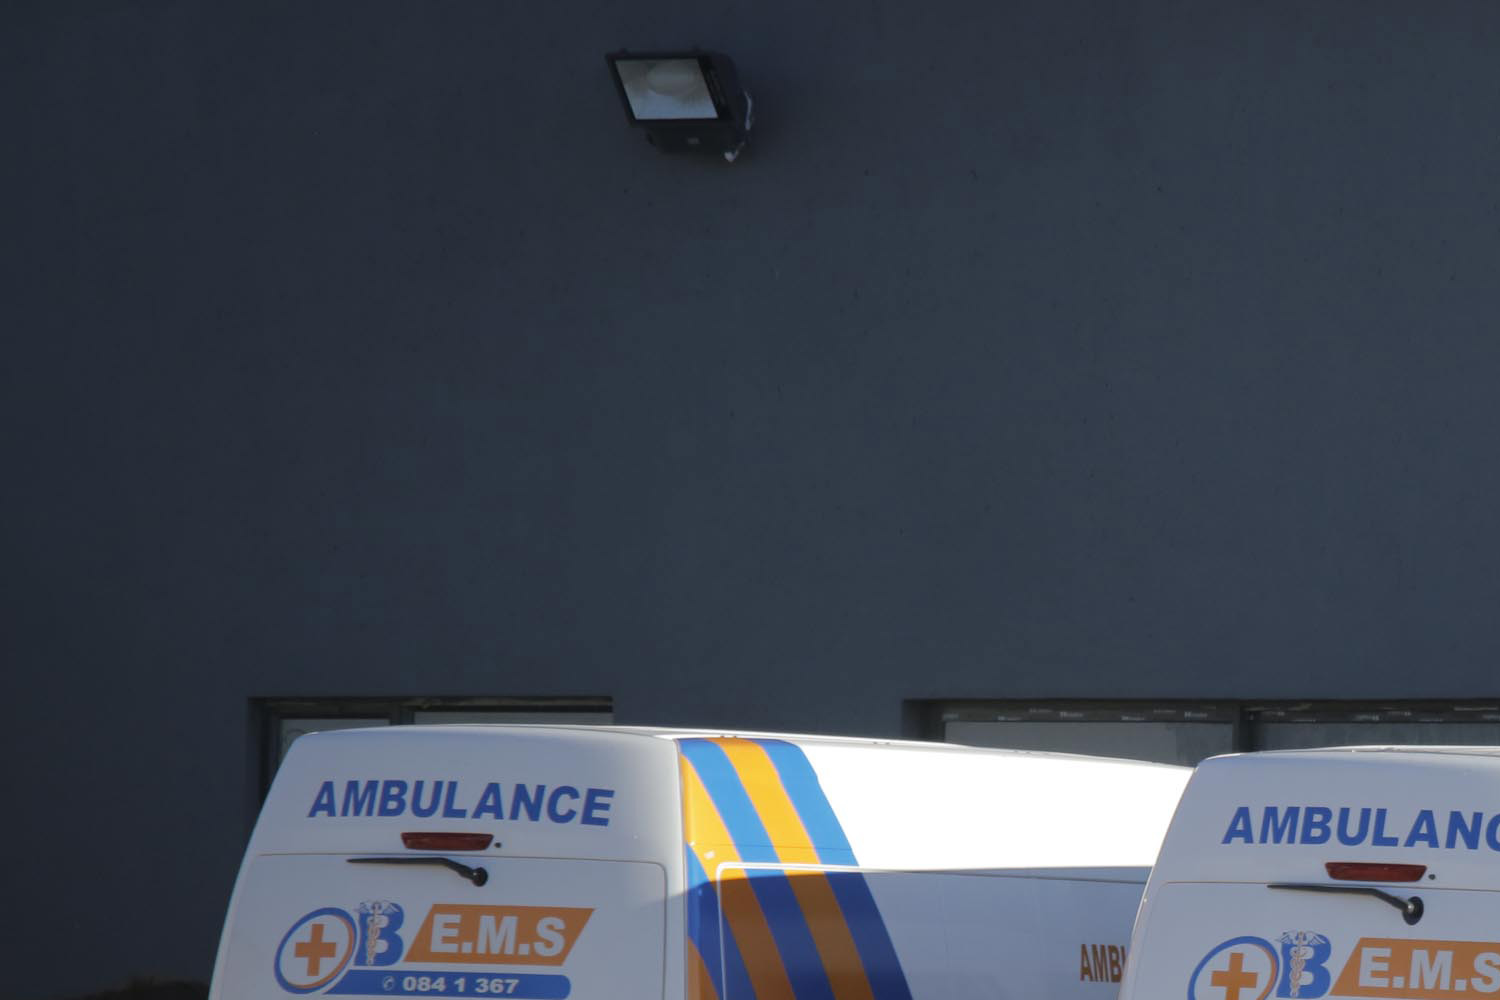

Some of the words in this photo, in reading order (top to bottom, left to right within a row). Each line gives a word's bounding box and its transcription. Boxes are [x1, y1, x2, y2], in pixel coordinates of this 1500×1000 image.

[307, 779, 616, 827] AMBULANCE
[429, 913, 567, 958] E.M.S
[402, 976, 447, 992] 084
[454, 977, 466, 993] 1
[475, 978, 520, 994] 367
